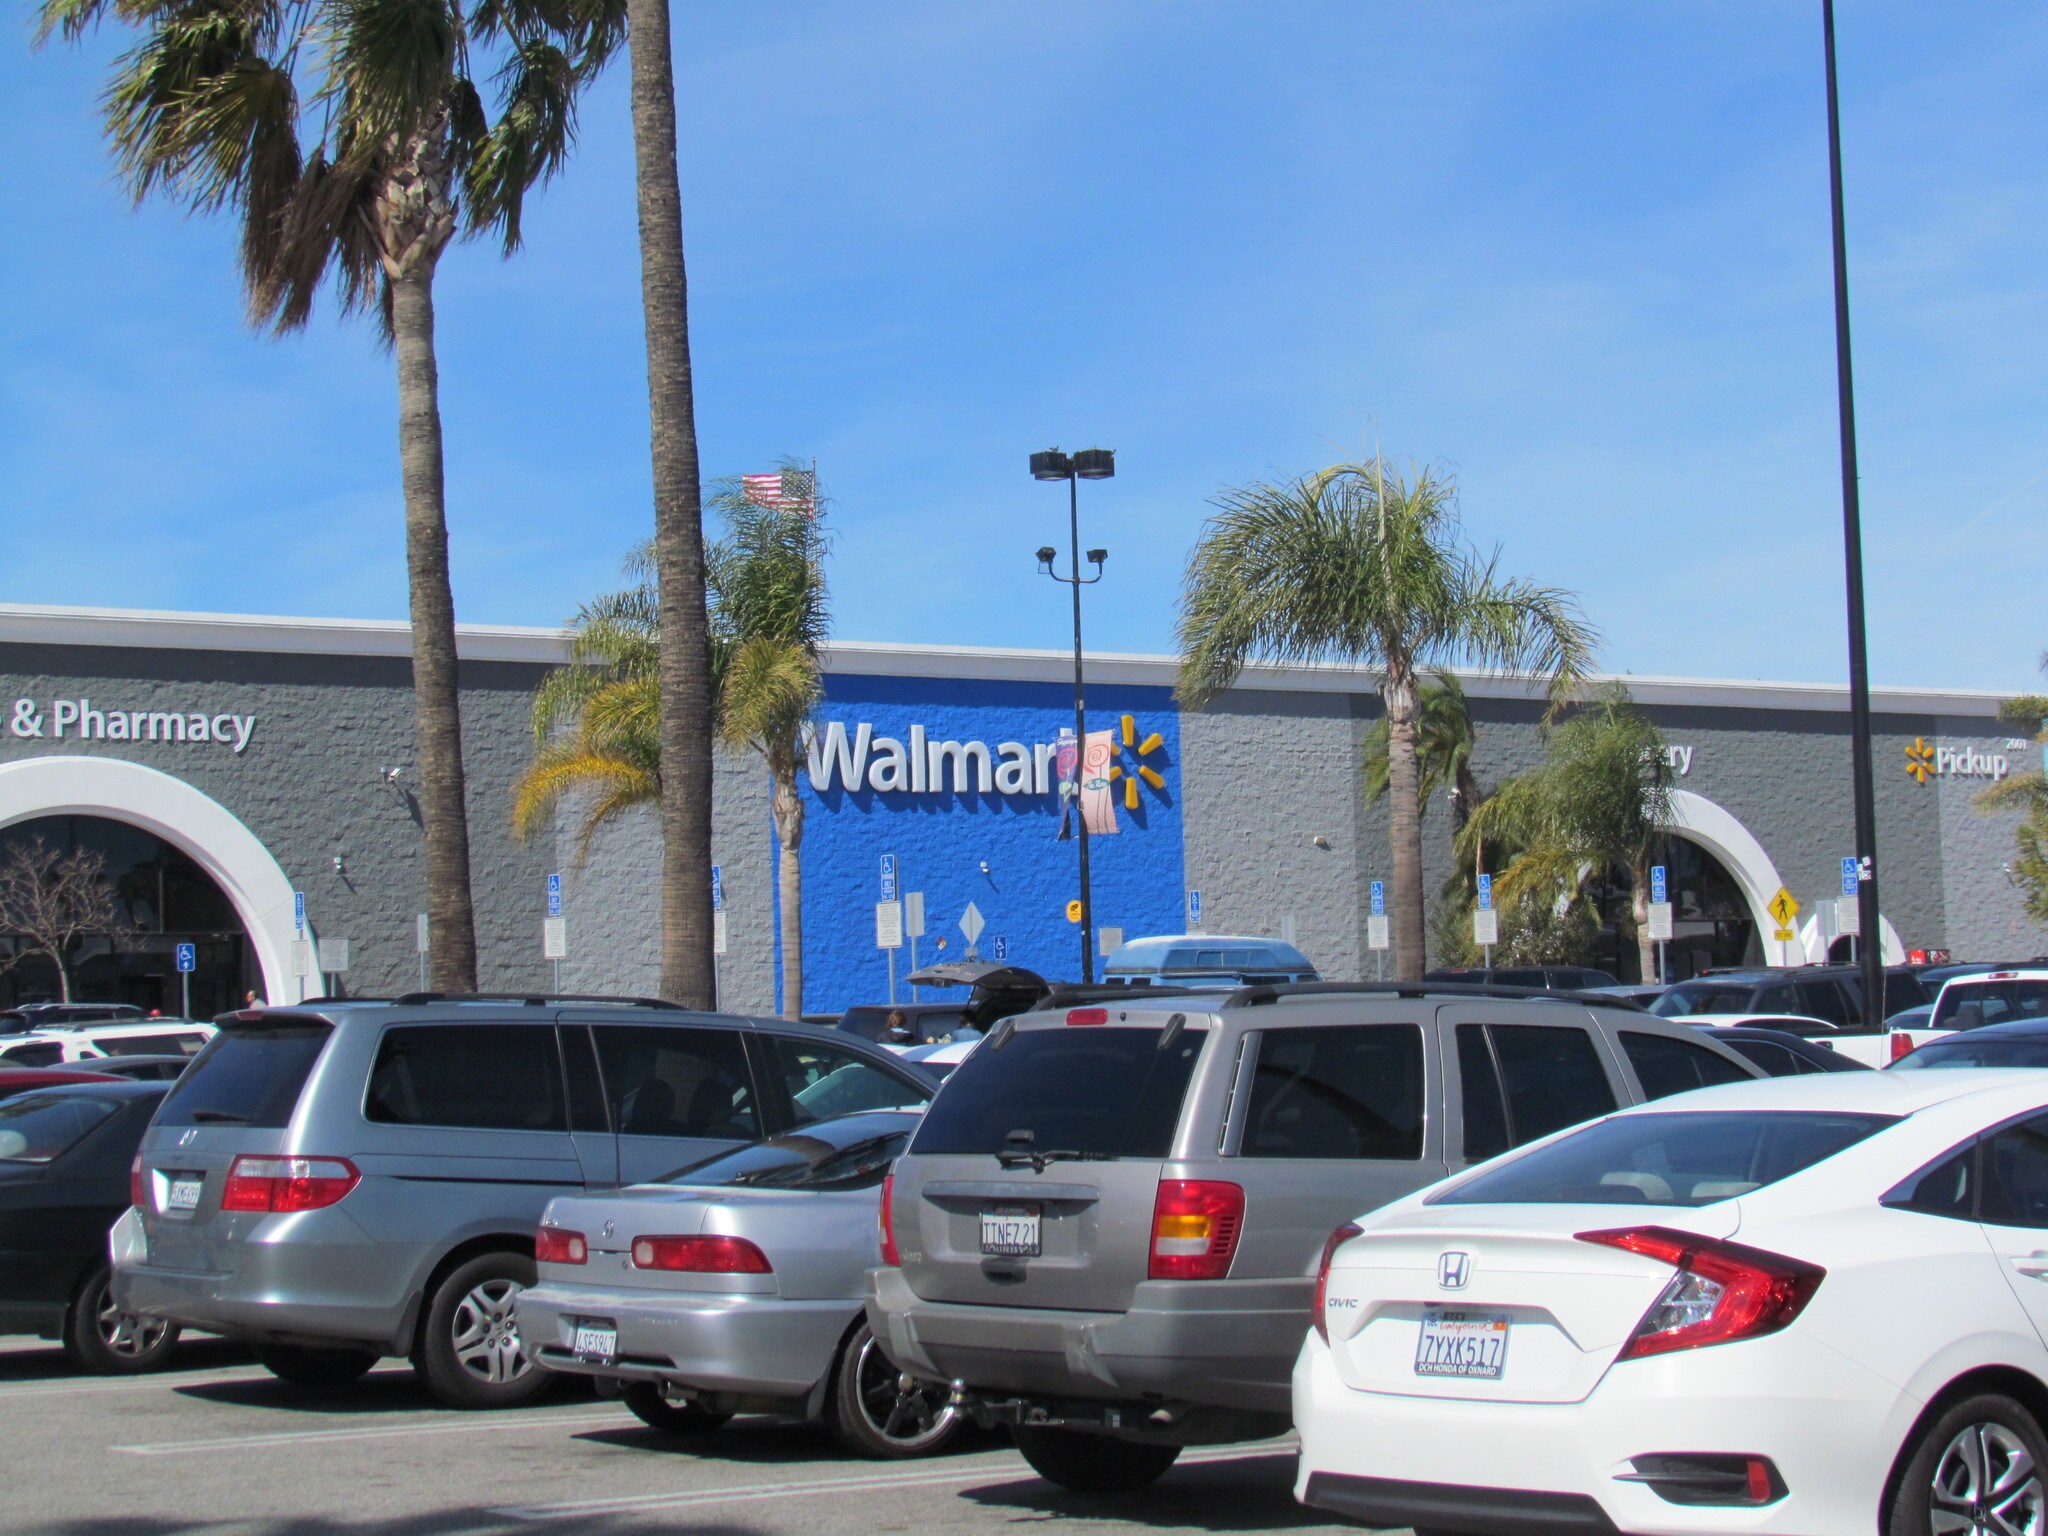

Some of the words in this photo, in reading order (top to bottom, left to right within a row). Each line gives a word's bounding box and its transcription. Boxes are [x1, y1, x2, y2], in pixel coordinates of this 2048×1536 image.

[11, 698, 44, 737] &
[54, 699, 256, 752] Pharmacy
[2005, 738, 2027, 750] 2001
[799, 720, 1080, 795] Walmar
[1936, 746, 2009, 781] Pickup
[1328, 1297, 1359, 1308] CIVIC
[1439, 1319, 1490, 1335] California
[1424, 1335, 1500, 1366] 7YXK517
[1418, 1362, 1434, 1373] DCH
[1433, 1363, 1457, 1375] HONDA
[1457, 1365, 1468, 1375] OF
[1468, 1365, 1497, 1377] OXNARD
